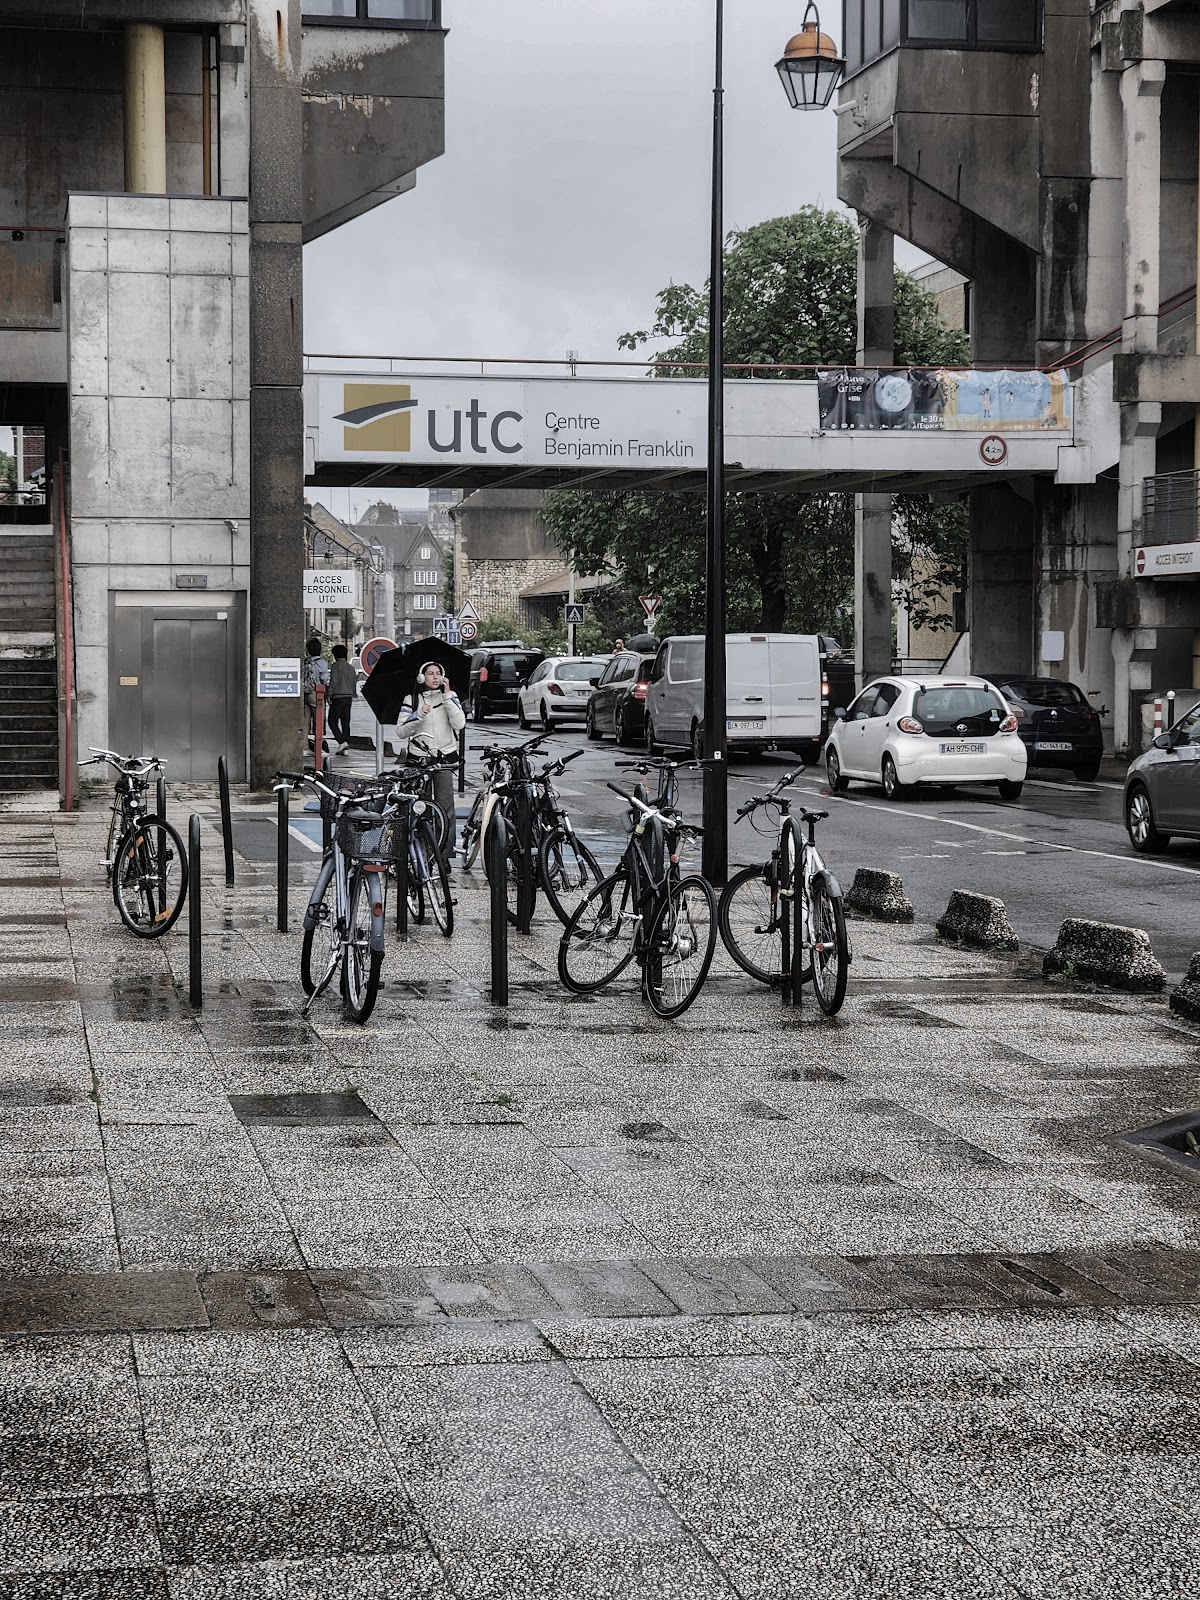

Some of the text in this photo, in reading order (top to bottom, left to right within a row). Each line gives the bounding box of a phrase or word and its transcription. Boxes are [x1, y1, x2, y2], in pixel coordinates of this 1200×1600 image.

[838, 383, 862, 393] Grise
[545, 411, 600, 430] Centre
[929, 414, 938, 422] 30
[427, 398, 524, 454] utc
[545, 437, 694, 460] Benjamin Franklin
[313, 575, 342, 584] ACCES
[303, 585, 353, 594] PERSONNEL
[318, 595, 336, 604] UTC
[463, 626, 473, 635] 30
